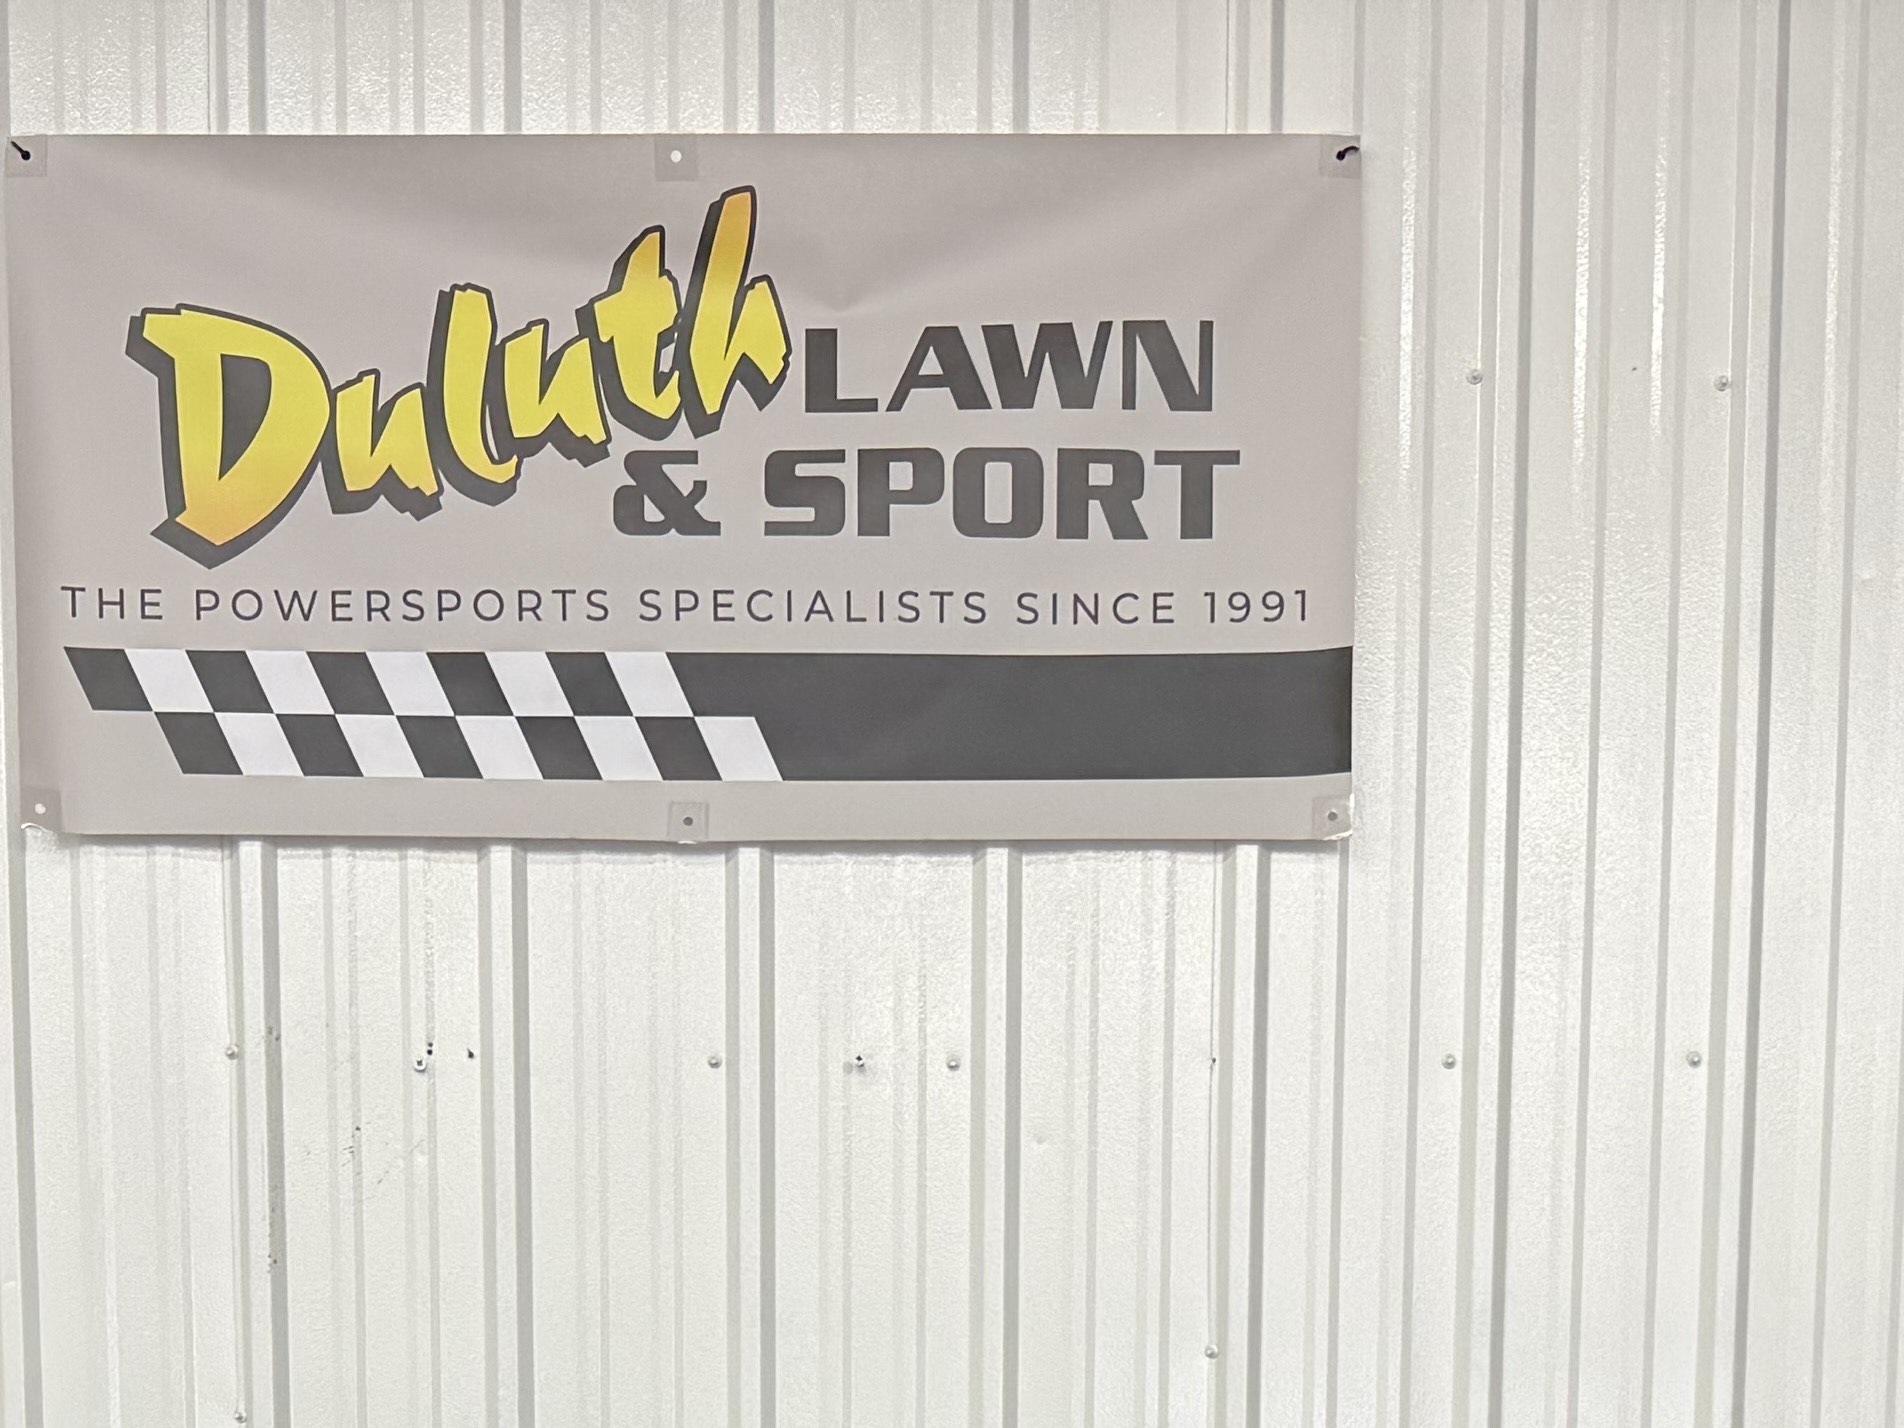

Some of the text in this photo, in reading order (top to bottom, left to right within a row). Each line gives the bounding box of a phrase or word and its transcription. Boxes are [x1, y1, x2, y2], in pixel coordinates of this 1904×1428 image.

[125, 186, 1214, 568] Duluth LAWN
[612, 448, 1241, 540] & SPORT
[61, 587, 1309, 626] THE POWERSPORTS SPECIALISTS SINCE 1991
